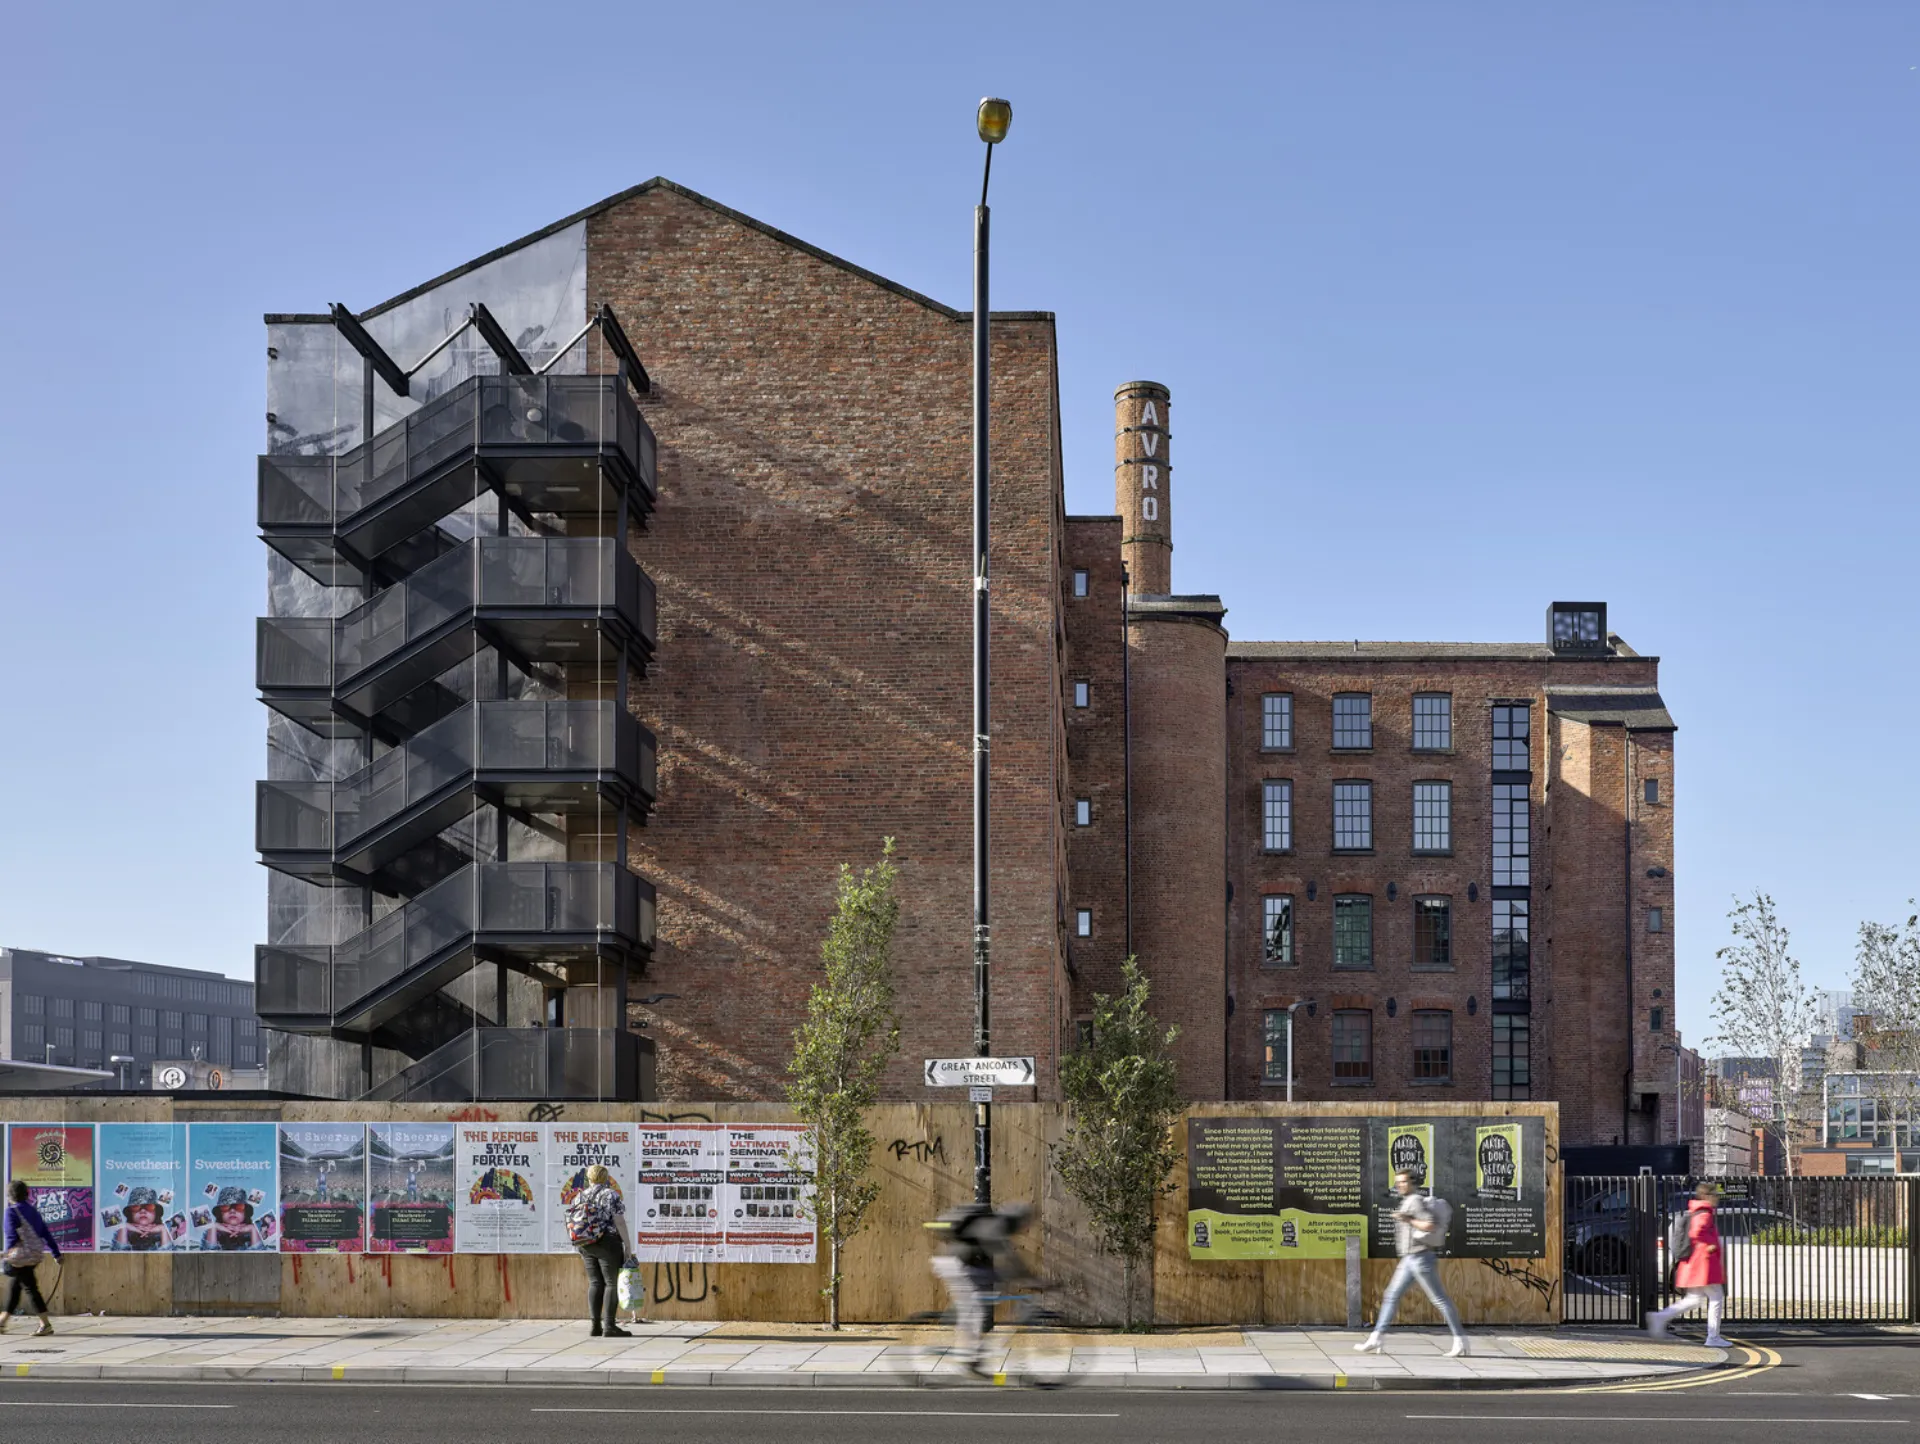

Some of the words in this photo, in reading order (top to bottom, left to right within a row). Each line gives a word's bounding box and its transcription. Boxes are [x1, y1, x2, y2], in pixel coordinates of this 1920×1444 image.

[1141, 401, 1159, 521] AVRO
[941, 1062, 970, 1071] GREAT
[975, 1061, 1019, 1070] ANCOATS
[963, 1074, 996, 1083] STREET
[287, 1132, 300, 1142] Ed
[305, 1132, 358, 1142] Sheeran
[377, 1132, 390, 1142] Ed
[395, 1132, 449, 1142] Sheeran
[464, 1131, 488, 1142] THE
[492, 1131, 539, 1143] REFUGE
[554, 1131, 578, 1143] THE
[583, 1131, 629, 1143] REFUGE
[642, 1132, 667, 1140] THE
[642, 1140, 702, 1148] ULTIMATE
[1337, 1142, 1348, 1150] get
[1395, 1136, 1418, 1150] MAYBE
[1482, 1136, 1505, 1150] MAYBE
[486, 1144, 518, 1154] STAY
[576, 1144, 608, 1155] STAY
[642, 1148, 699, 1156] SEMINAR
[472, 1155, 531, 1168] FOREVER
[563, 1155, 621, 1168] FOREVER
[1394, 1153, 1398, 1164] I
[1400, 1150, 1422, 1162] DON'T
[1481, 1153, 1486, 1163] I
[1488, 1150, 1509, 1162] DON'T
[105, 1159, 181, 1170] Sweetheart
[195, 1158, 272, 1170] Sweetheart
[1483, 1164, 1512, 1176] BELONG
[1487, 1176, 1505, 1186] HERE
[37, 1191, 68, 1209] FAT
[1238, 1221, 1261, 1229] writing
